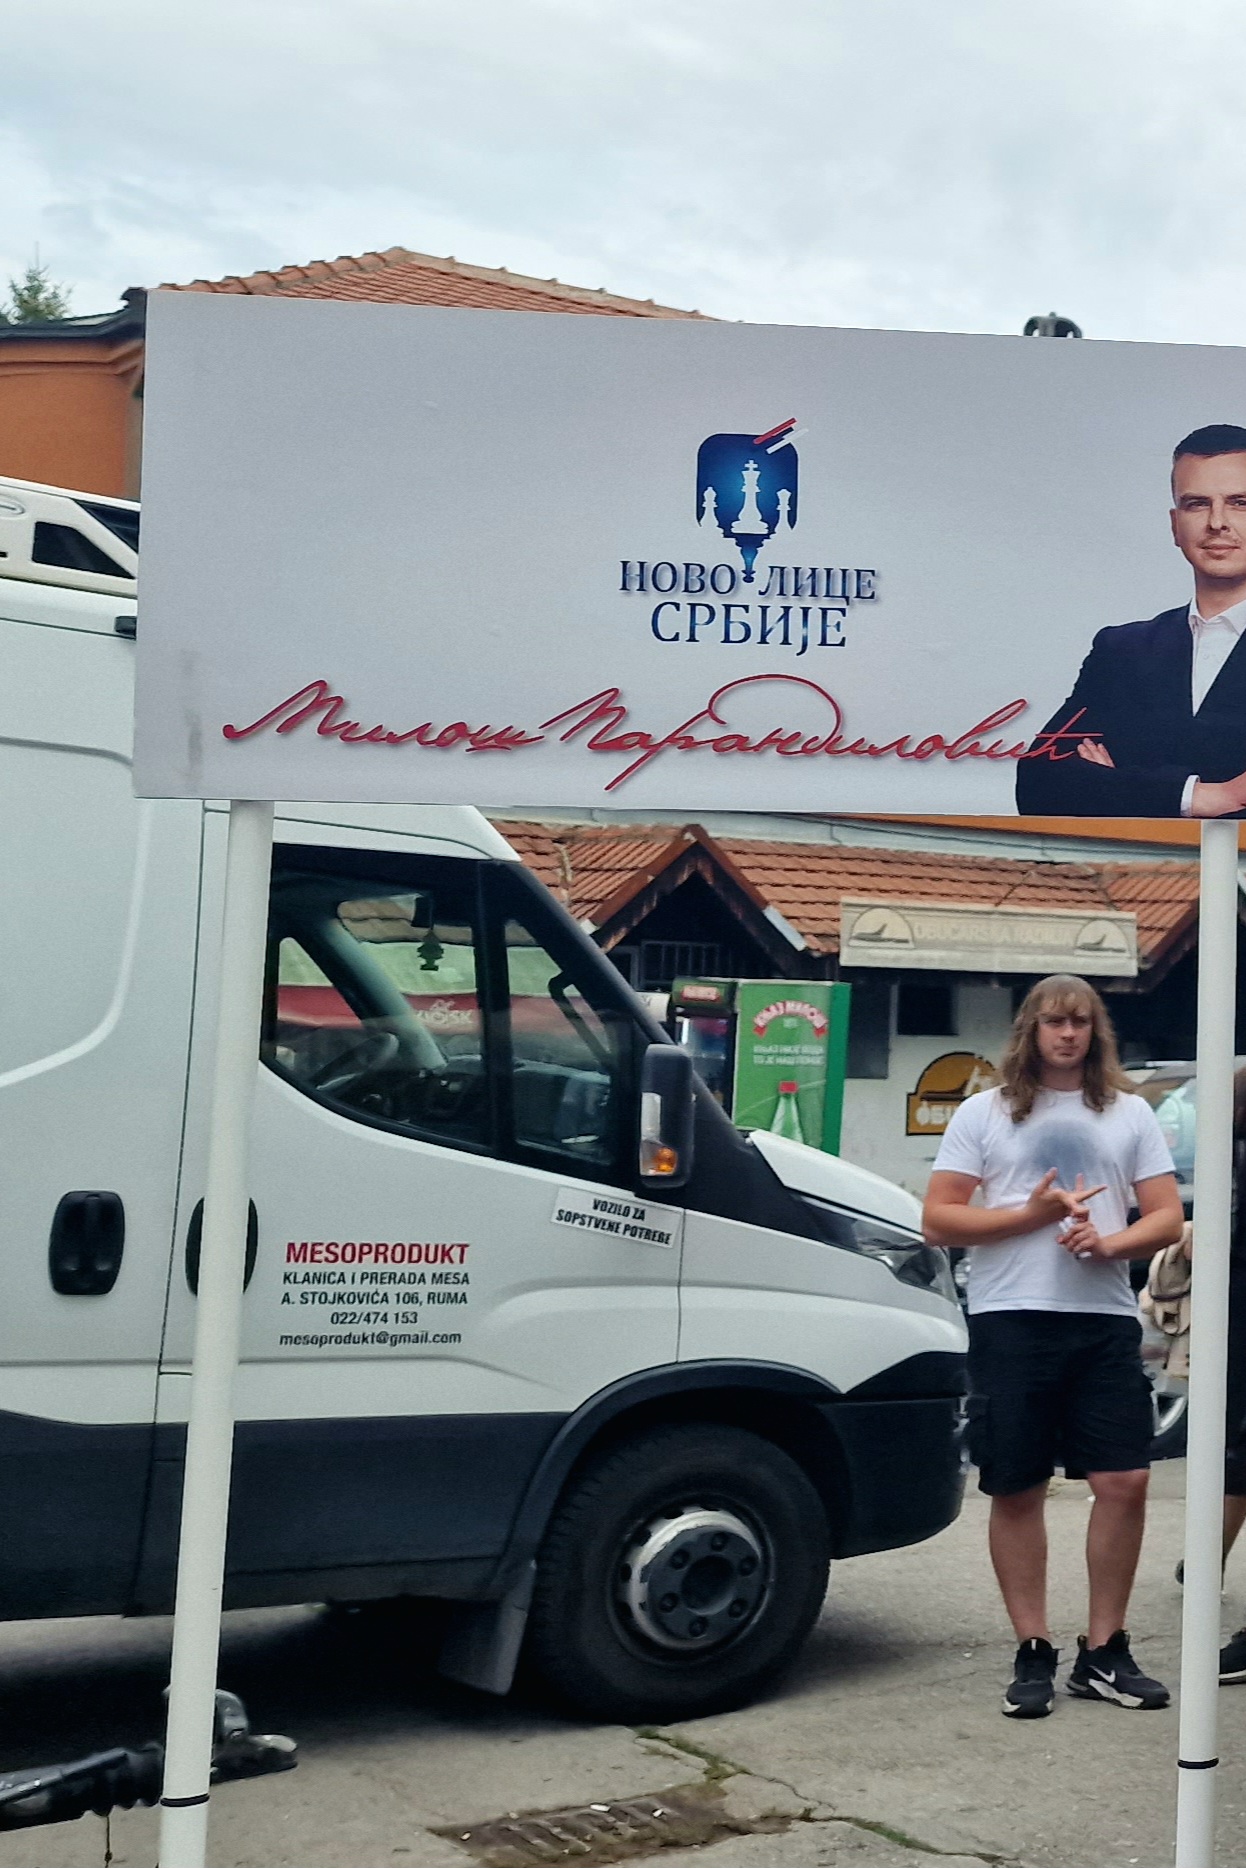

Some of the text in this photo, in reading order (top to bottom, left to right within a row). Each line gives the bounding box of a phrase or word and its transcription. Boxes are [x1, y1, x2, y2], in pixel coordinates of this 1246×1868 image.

[619, 560, 876, 606] НОВО ЛИЦЕ
[651, 601, 847, 657] СРБИЈЕ
[592, 1197, 647, 1221] VOZILO ZA
[555, 1208, 622, 1234] SOPSTVENE
[286, 1242, 469, 1265] MESOPRODUKT
[282, 1271, 470, 1286] KLANICA I PRERADA MESA
[280, 1288, 468, 1308] A. STOJKOVIĆA 106, RUMA
[330, 1311, 419, 1325] 022/474 153
[279, 1330, 462, 1349] mesoprodukt@gmail.com
